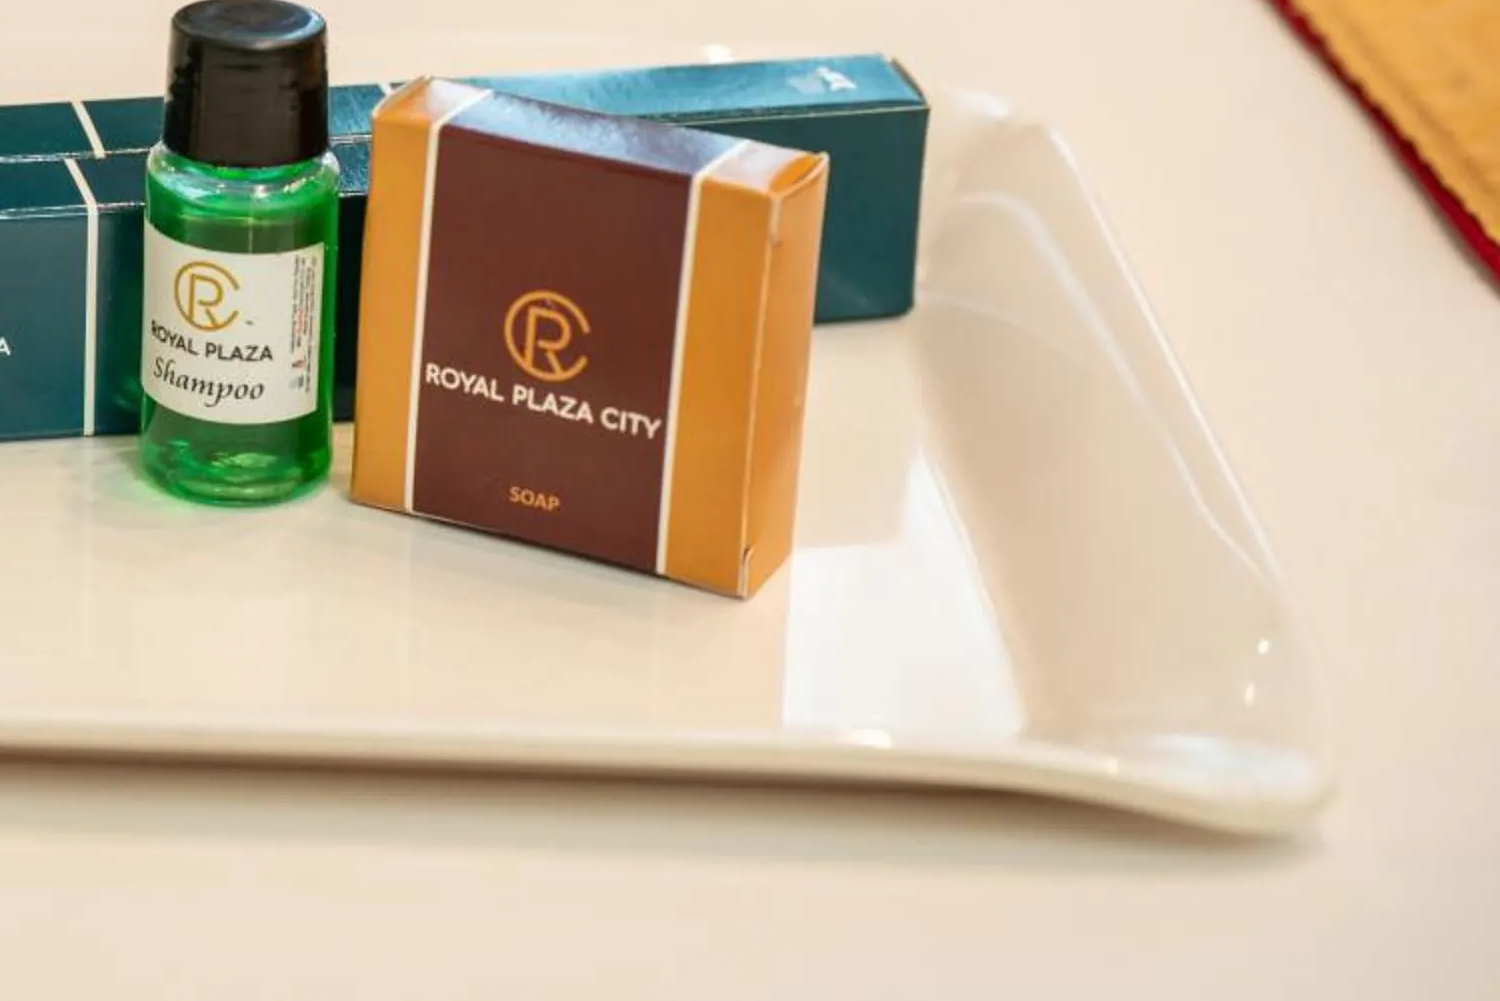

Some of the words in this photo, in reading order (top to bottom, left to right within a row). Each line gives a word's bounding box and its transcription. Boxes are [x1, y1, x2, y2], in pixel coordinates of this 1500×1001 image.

[151, 318, 199, 357] ROYAL
[205, 341, 274, 363] PLAZA
[152, 355, 265, 409] Shampoo
[424, 362, 505, 403] ROYAL
[511, 384, 595, 425] PLAZA
[599, 406, 662, 441] CITY
[508, 485, 561, 512] SOAP
